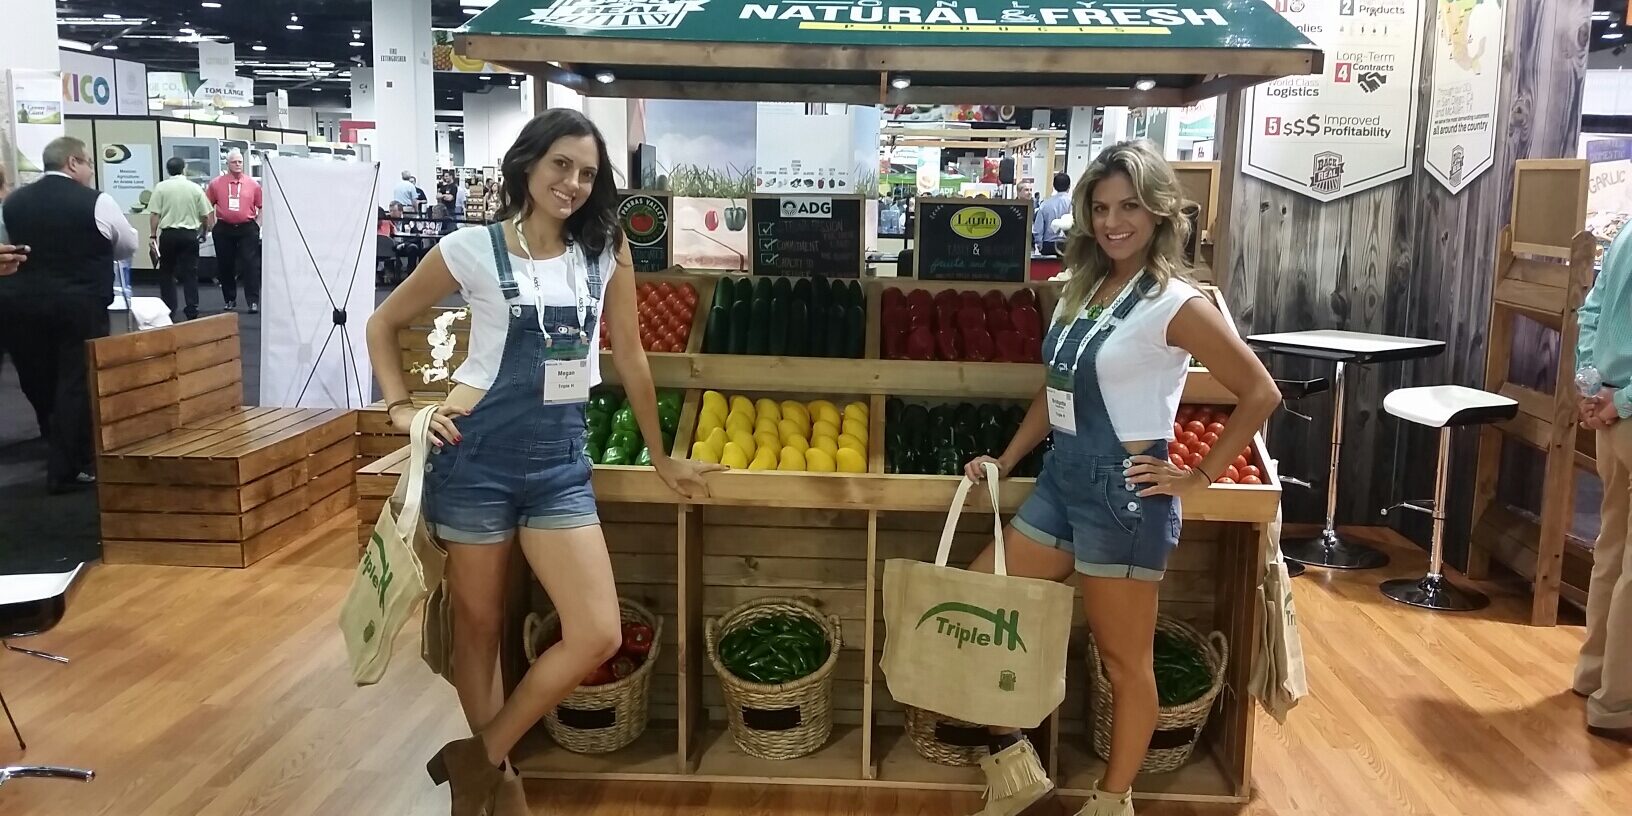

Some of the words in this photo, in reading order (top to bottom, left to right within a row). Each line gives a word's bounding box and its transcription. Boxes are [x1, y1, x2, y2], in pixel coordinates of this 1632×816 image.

[738, 3, 997, 24] NATURAL
[1000, 8, 1040, 23] &
[1039, 8, 1229, 26] FRESH
[1336, 51, 1395, 63] Long-Term
[1337, 64, 1348, 81] 4
[1352, 63, 1394, 72] Contracts
[1295, 78, 1320, 87] Class
[204, 87, 222, 95] TOM
[223, 87, 245, 96] LANGE
[1266, 86, 1320, 98] Logistics
[1268, 118, 1278, 134] 5
[1324, 114, 1381, 126] Improved
[1440, 123, 1457, 135] around
[1458, 121, 1467, 132] the
[1467, 120, 1489, 132] country
[1323, 126, 1392, 139] Profitability
[1318, 157, 1338, 170] BACK
[1318, 169, 1338, 180] REAL
[1588, 170, 1626, 194] GARLIC
[621, 197, 643, 216] PARRAS
[645, 198, 665, 220] VALLEY
[798, 202, 831, 214] ADG
[972, 242, 981, 256] &
[936, 616, 991, 649] Triple
[993, 608, 1019, 651] H
